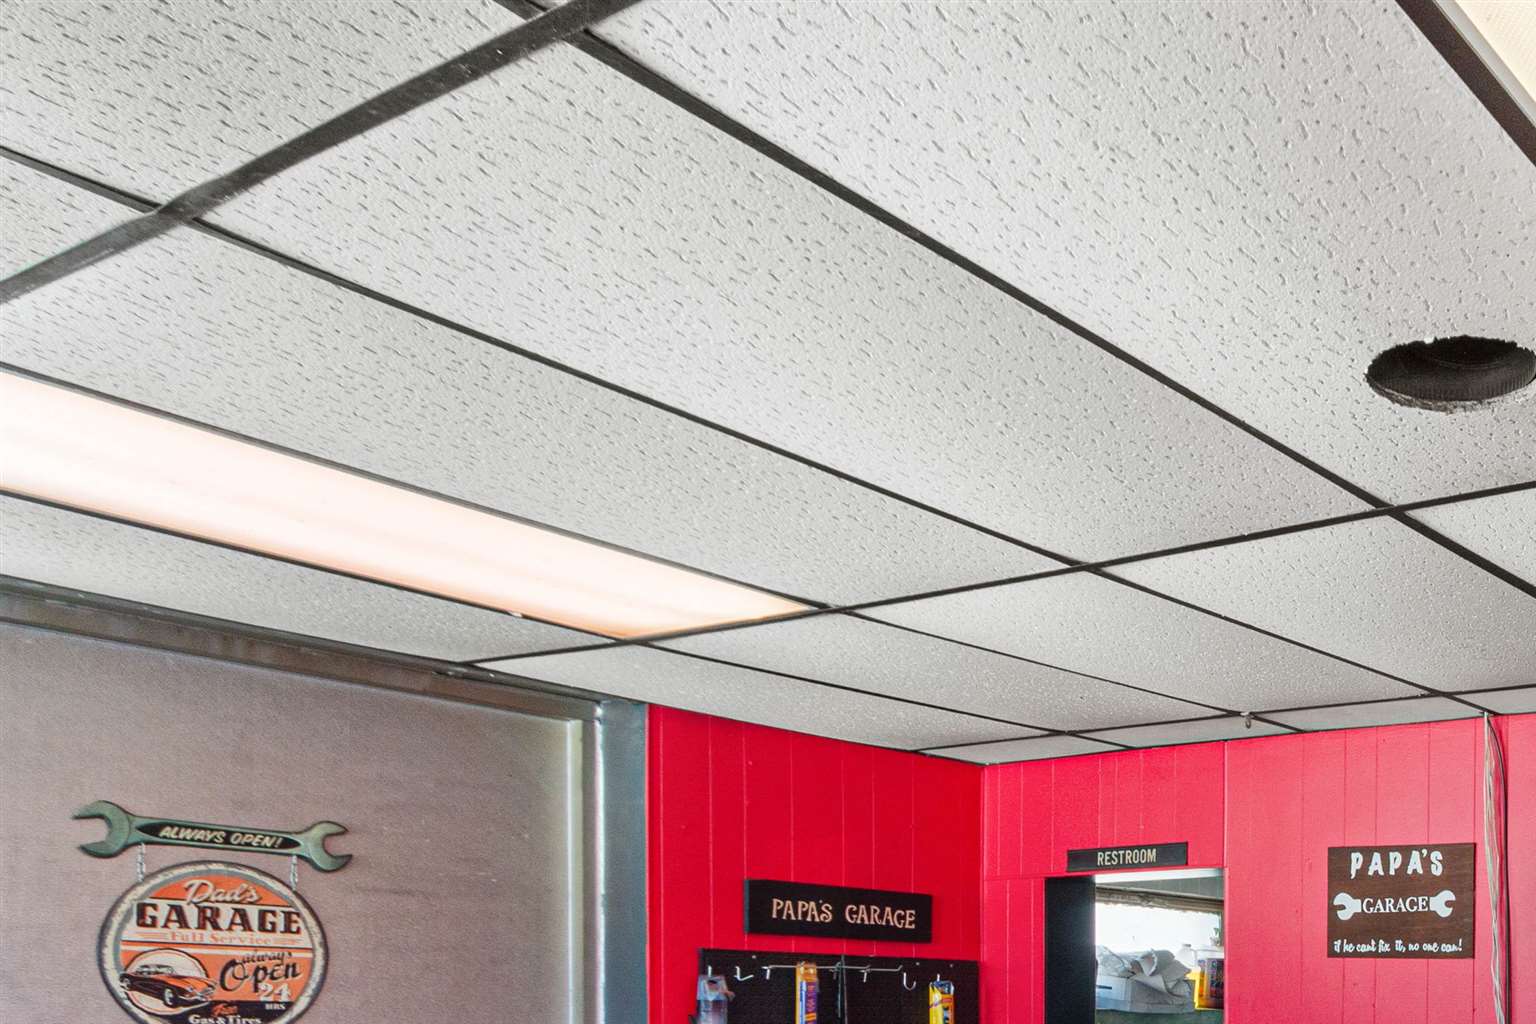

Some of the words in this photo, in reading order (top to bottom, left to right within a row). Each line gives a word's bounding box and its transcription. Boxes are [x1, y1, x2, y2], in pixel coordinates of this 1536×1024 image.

[159, 826, 226, 844] ALWAYS
[231, 834, 282, 848] OPEN!
[1097, 848, 1156, 866] RESTROOM
[1351, 849, 1443, 879] PAPA'S
[185, 879, 260, 905] Dad's
[772, 898, 833, 922] PAPA'S
[845, 904, 916, 929] GARAGE
[1362, 896, 1428, 914] GARAGE
[136, 902, 302, 935] GARAGE
[171, 931, 204, 942] Full
[209, 933, 271, 945] Service
[1343, 939, 1355, 952] he
[1378, 939, 1390, 952] fix
[1408, 942, 1419, 951] no
[1423, 942, 1439, 952] one
[220, 959, 302, 992] Open
[259, 984, 291, 1002] 24
